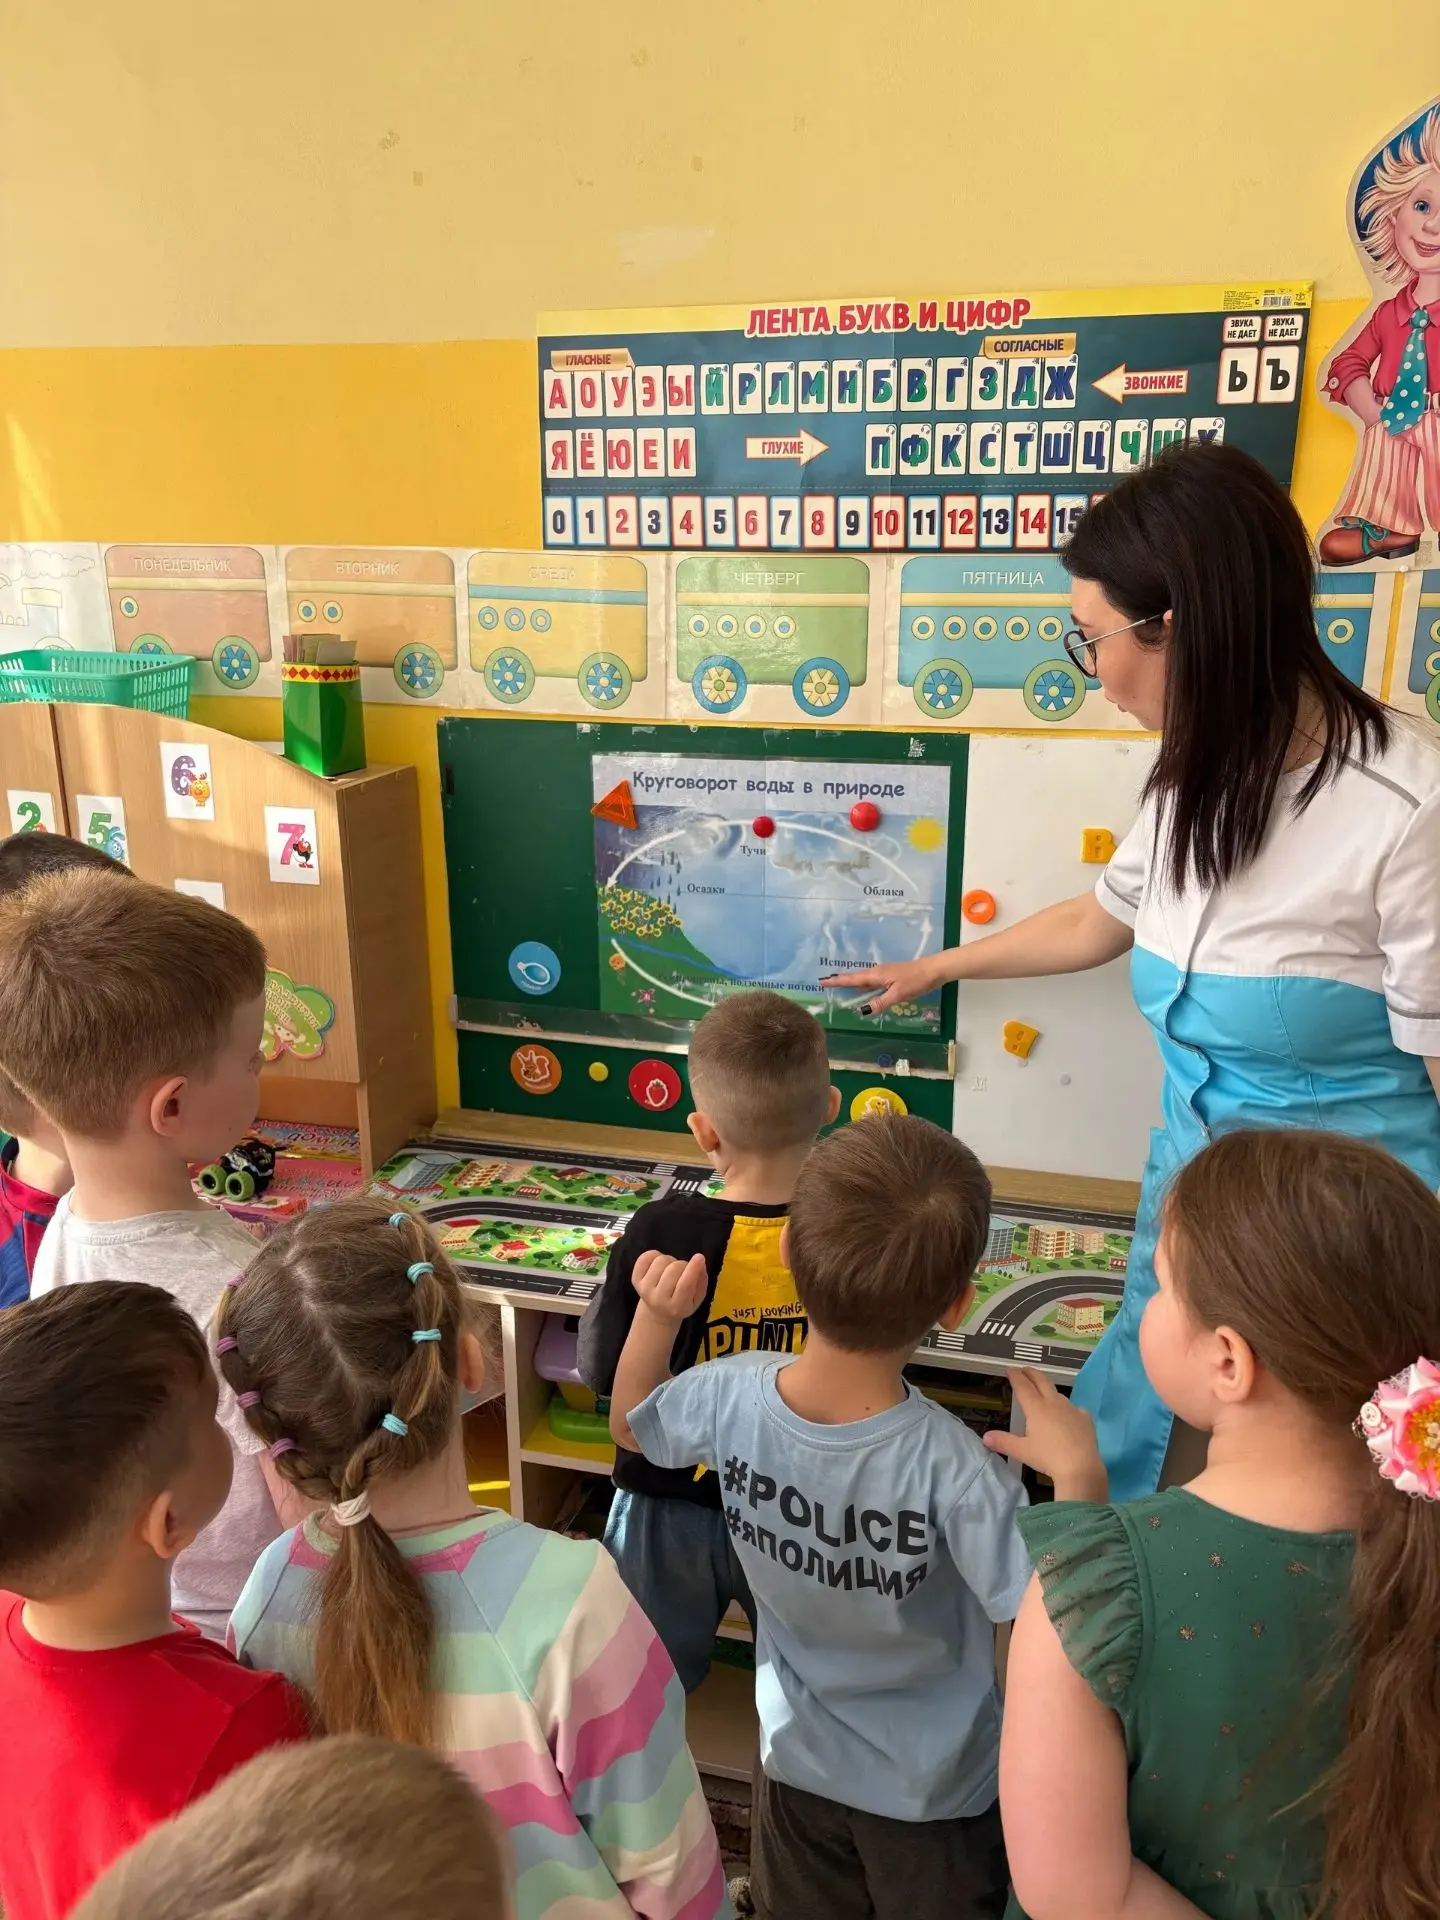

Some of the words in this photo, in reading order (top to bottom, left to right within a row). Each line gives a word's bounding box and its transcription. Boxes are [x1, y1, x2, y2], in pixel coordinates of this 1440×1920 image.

[746, 306, 832, 335] ЛЕНТА
[838, 302, 911, 332] БУКВ
[919, 302, 937, 328] И
[945, 299, 1031, 330] ЦИФР
[1230, 318, 1254, 328] ЗВУКА
[1271, 317, 1296, 327] ЗВУКА
[1227, 330, 1237, 339] НЕ
[1237, 329, 1258, 339] ДАЕТ
[1268, 328, 1278, 338] НЕ
[1279, 327, 1299, 338] ДАЕТ
[993, 338, 1065, 353] СОГЛАСНЫЕ
[565, 353, 612, 367] ГЛАСНЫЕ
[1123, 374, 1184, 391] ЗВОНКИЕ
[1228, 360, 1248, 392] Ь
[1266, 358, 1290, 391] Ъ
[549, 382, 568, 409] А
[580, 377, 596, 408] О
[611, 376, 628, 408] У
[642, 376, 657, 407] Э
[667, 375, 693, 407] Ы
[705, 367, 725, 406] Й
[740, 372, 756, 405] Р
[768, 371, 790, 405] Л
[801, 370, 825, 404] М
[836, 370, 858, 404] Н
[871, 369, 893, 403] Б
[906, 368, 928, 403] В
[945, 368, 965, 403] Г
[978, 366, 998, 400] З
[1011, 366, 1037, 406] Д
[1043, 365, 1076, 400] Ж
[551, 440, 568, 470] Я
[580, 432, 595, 470] Ё
[607, 439, 631, 470] Ю
[643, 438, 658, 469] Е
[673, 438, 690, 469] И
[762, 441, 804, 455] ГЛУХИЕ
[871, 436, 890, 469] П
[901, 434, 929, 467] Ф
[941, 433, 962, 467] К
[979, 432, 997, 467] С
[1013, 432, 1034, 467] Т
[1043, 432, 1072, 466] Ш
[1082, 431, 1105, 470] Ц
[1120, 430, 1141, 465] Ч
[553, 510, 566, 535] 0
[585, 510, 595, 534] 1
[615, 508, 629, 534] 2
[647, 510, 661, 535] 3
[679, 510, 694, 534] 4
[713, 510, 727, 534] 5
[745, 510, 760, 535] 6
[778, 510, 792, 534] 7
[811, 510, 826, 535] 8
[845, 510, 860, 535] 9
[873, 509, 900, 535] 10
[912, 509, 936, 535] 11
[947, 509, 974, 535] 12
[982, 508, 1009, 534] 13
[1019, 508, 1047, 534] 14
[133, 557, 232, 572] ПОНЕДЕЛЬНИК
[335, 560, 399, 576] ВТОРНИК
[528, 566, 576, 580] СРЕДА
[734, 571, 806, 586] ЧЕТВЕРГ
[962, 571, 1045, 588] ПЯТНИЦА
[171, 755, 196, 796] 6
[632, 771, 738, 793] Круговорот
[746, 777, 795, 795] воды
[803, 782, 814, 794] в
[823, 781, 905, 799] природе
[88, 812, 112, 850] 5
[278, 823, 306, 865] 7
[740, 844, 767, 857] Тучи
[686, 882, 726, 896] Осадки
[862, 886, 905, 898] Облака
[787, 983, 825, 993] потоки
[732, 1307, 757, 1319] JUST
[760, 1301, 803, 1318] LOOKING
[723, 1455, 929, 1556] #POLICE
